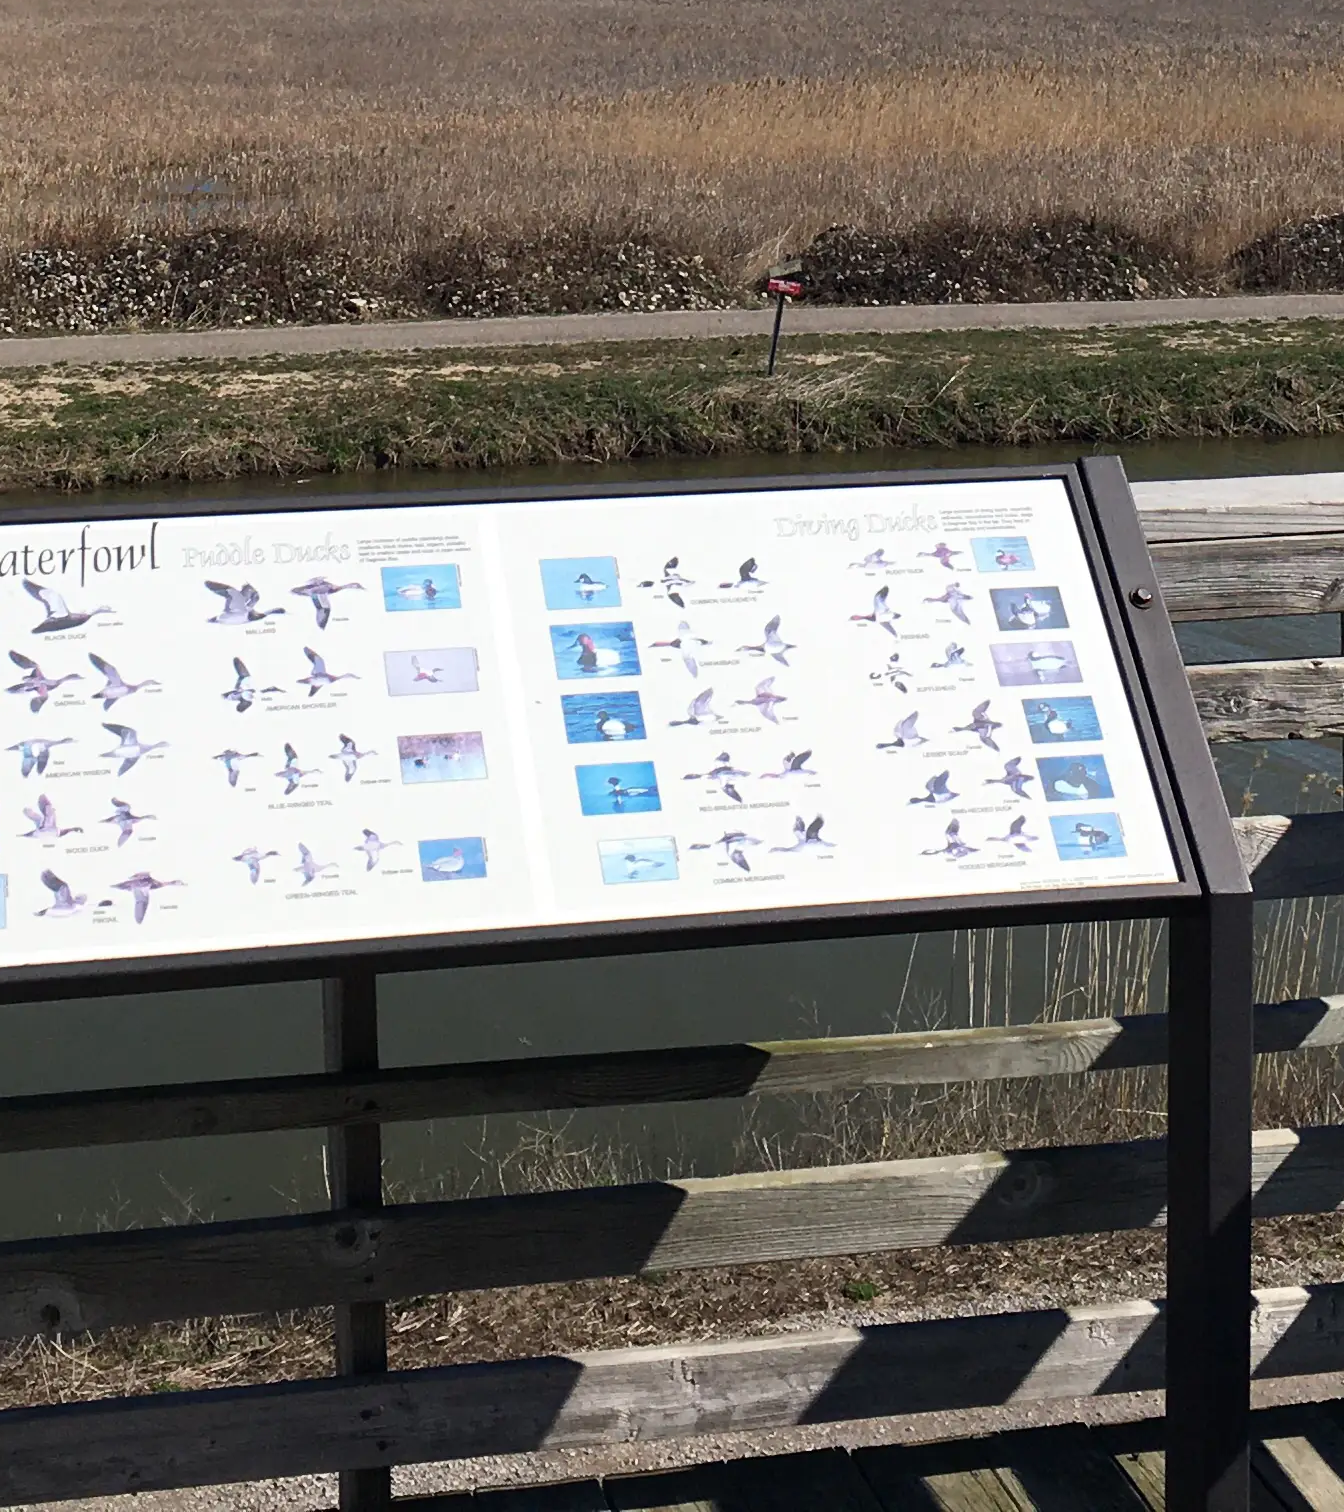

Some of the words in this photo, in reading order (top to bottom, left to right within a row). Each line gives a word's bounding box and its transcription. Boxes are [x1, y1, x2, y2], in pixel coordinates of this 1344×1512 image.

[773, 513, 860, 541] Diving
[863, 503, 938, 534] Ducks
[182, 535, 266, 568] Puddle
[271, 532, 351, 564] Ducks
